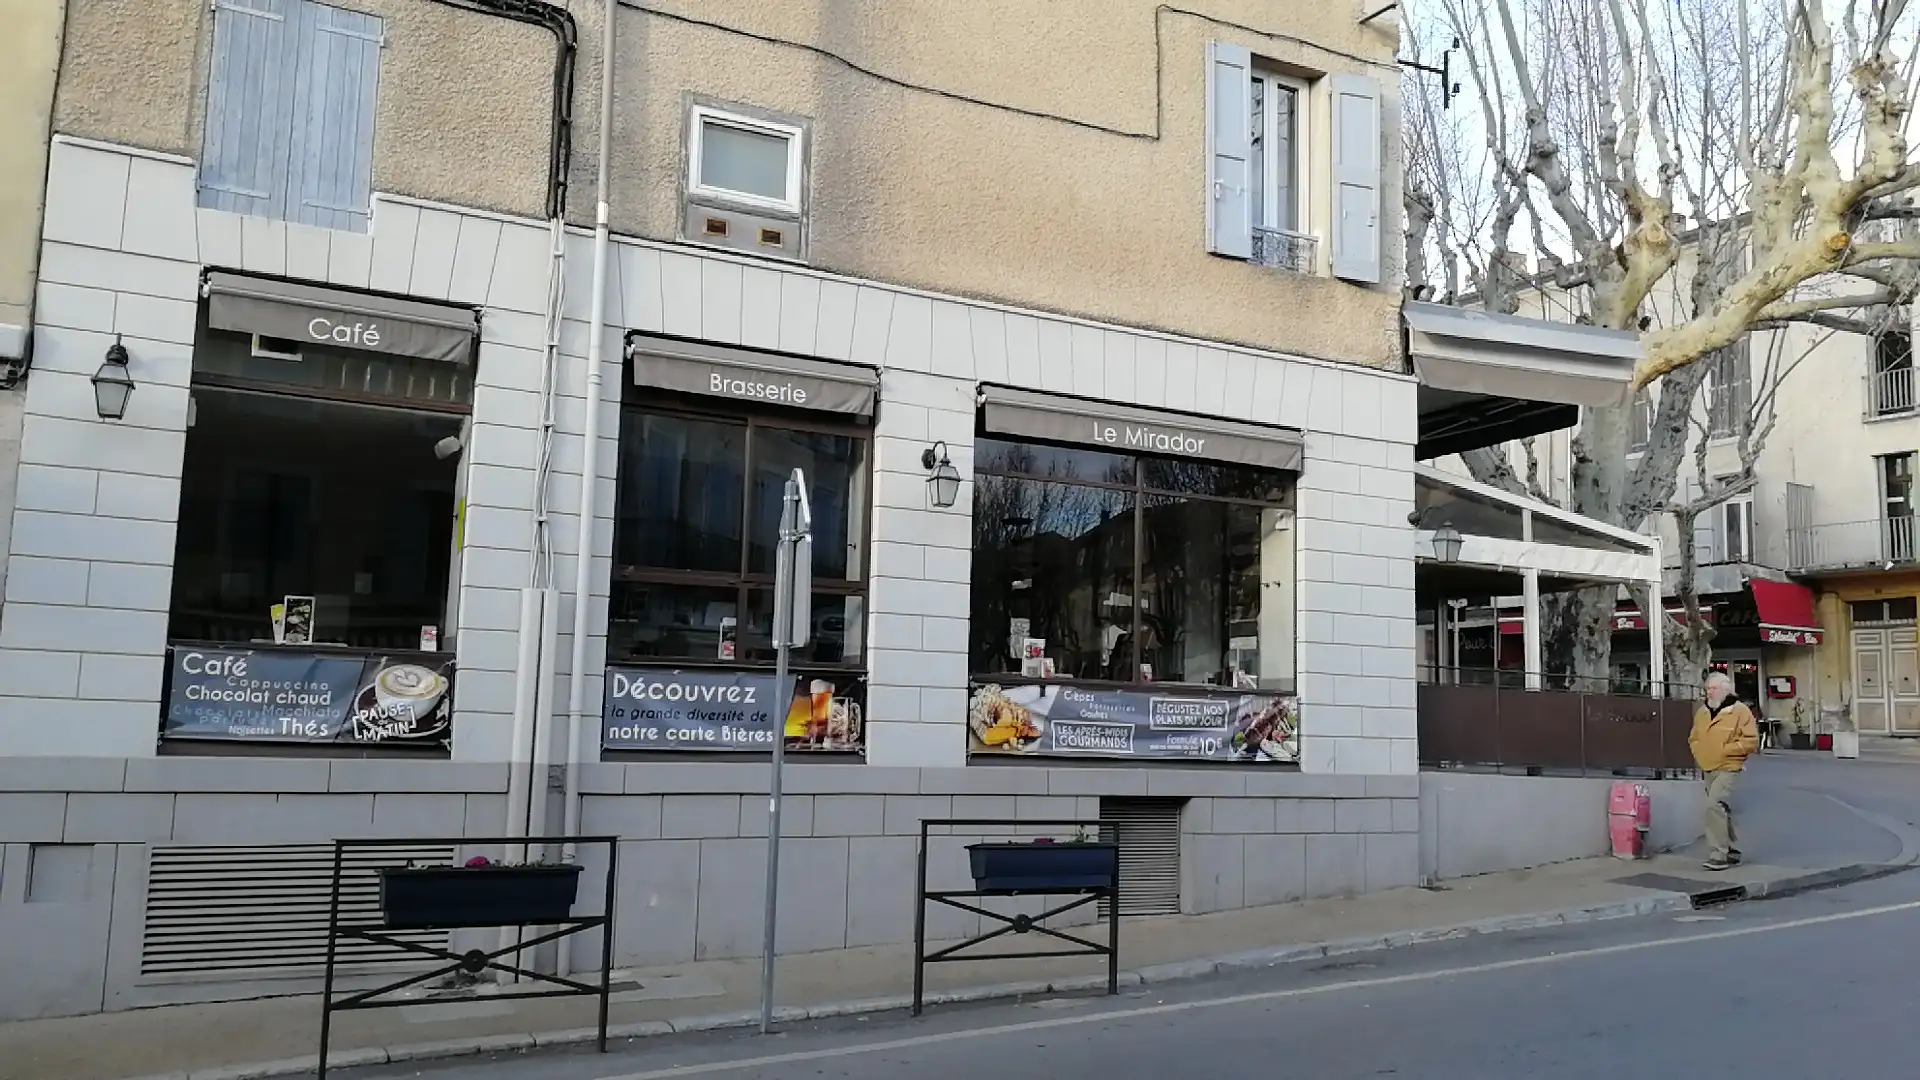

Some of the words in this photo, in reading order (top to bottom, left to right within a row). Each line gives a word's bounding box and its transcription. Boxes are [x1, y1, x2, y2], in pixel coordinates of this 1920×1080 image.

[309, 317, 380, 346] Café
[710, 373, 807, 403] Brasserie
[1093, 421, 1117, 443] Le
[1125, 426, 1205, 453] Mirador
[182, 652, 248, 678] Café
[226, 676, 329, 690] Cappuccino
[612, 673, 756, 704] Découvrez
[185, 684, 269, 704] Chocolat
[275, 690, 332, 706] chaud
[262, 704, 341, 719] Macchiato
[360, 702, 406, 724] PAUSE
[611, 704, 625, 719] la
[630, 707, 681, 721] grande
[687, 707, 744, 722] diversité
[750, 710, 767, 722] de
[1156, 702, 1201, 715] DÉGUSTEZ
[1203, 705, 1224, 716] NOS
[279, 717, 329, 737] Thés
[1057, 725, 1073, 735] LES
[1155, 714, 1183, 725] PLATS
[1184, 715, 1197, 726] DU
[1199, 716, 1223, 727] JOUR
[362, 721, 411, 742] MATIN
[608, 724, 658, 741] notre
[665, 727, 715, 742] carte
[722, 725, 773, 743] Bières
[1060, 735, 1128, 749] GOURMANDS
